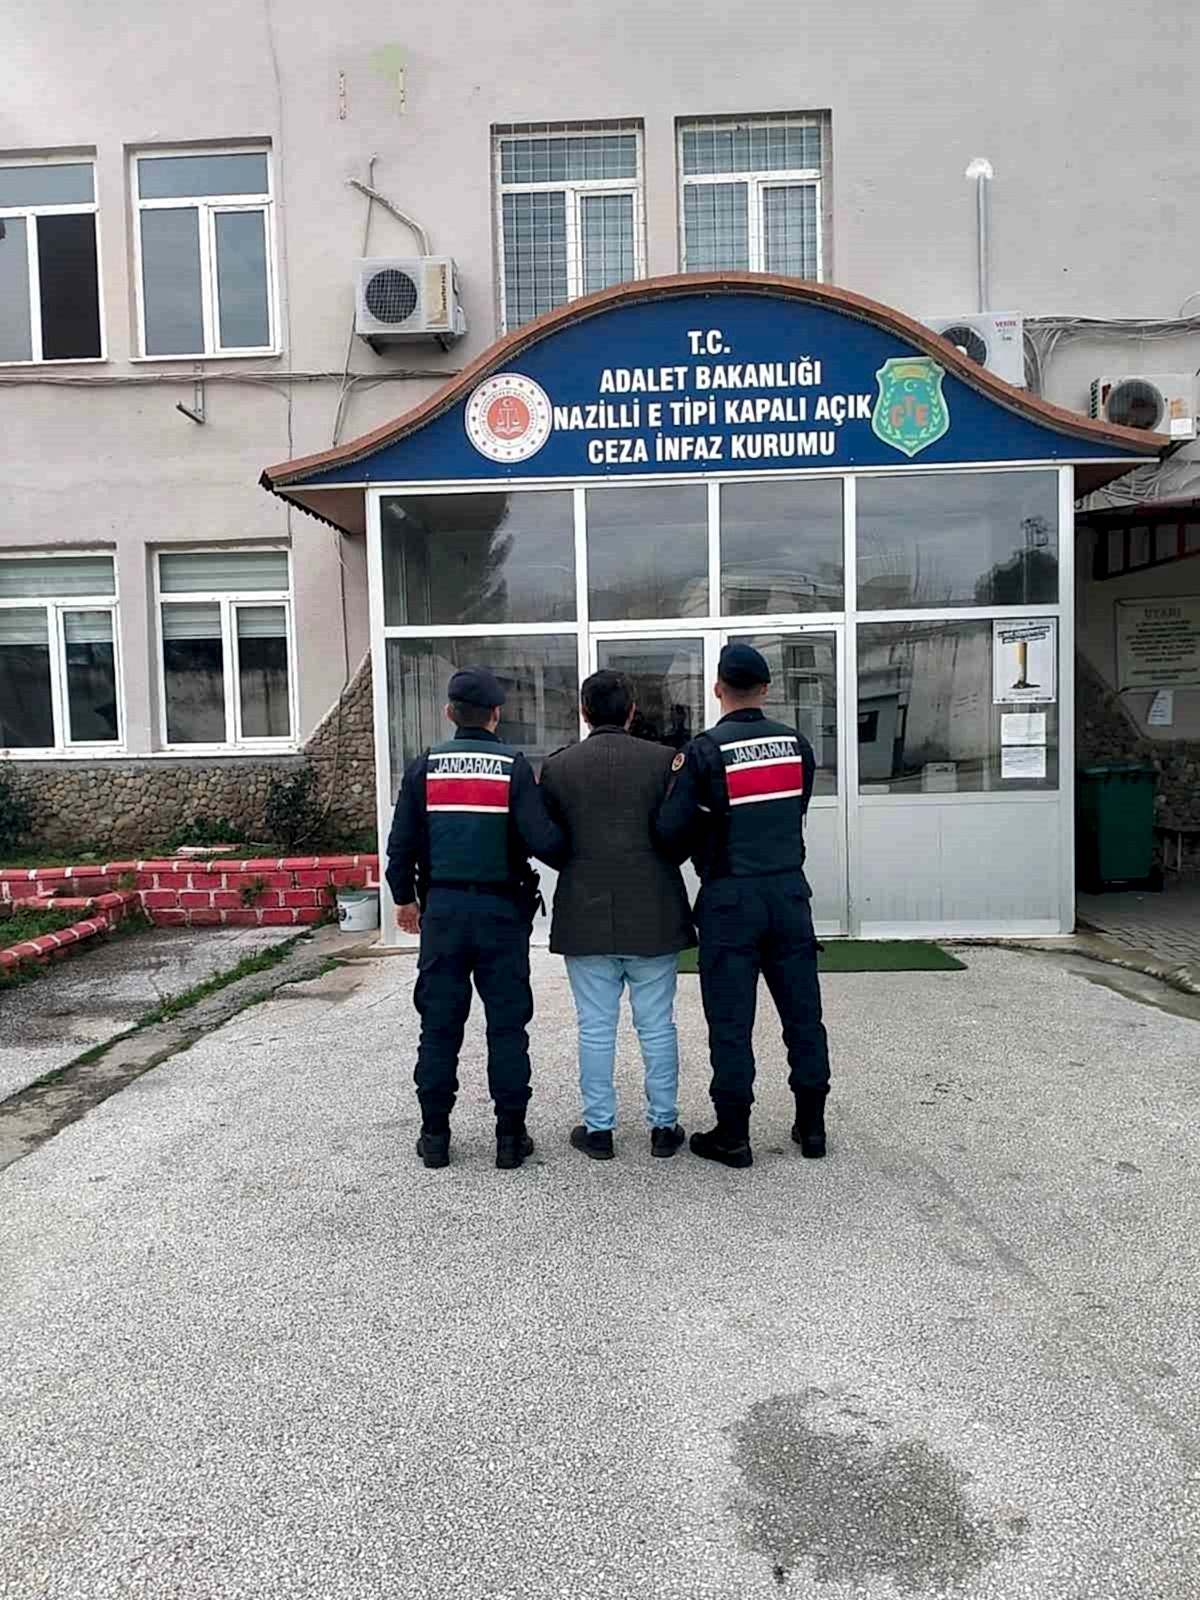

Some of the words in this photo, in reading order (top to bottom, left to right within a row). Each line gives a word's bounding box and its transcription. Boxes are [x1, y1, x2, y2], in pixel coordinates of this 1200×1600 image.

[687, 329, 731, 355] T.C.
[599, 366, 689, 393] ADALET
[695, 354, 822, 390] BAKANLIĞI
[553, 397, 640, 431] NAZİLLİ
[648, 403, 662, 427] E
[669, 394, 716, 426] TİPİ
[724, 396, 807, 425] KAPALI
[814, 394, 872, 427] AÇIK
[588, 437, 649, 464] CEZA
[656, 431, 723, 462] İNFAZ
[731, 431, 835, 459] KURUMU
[434, 757, 503, 774] JANDARMA
[732, 741, 796, 763] JANDARMA
